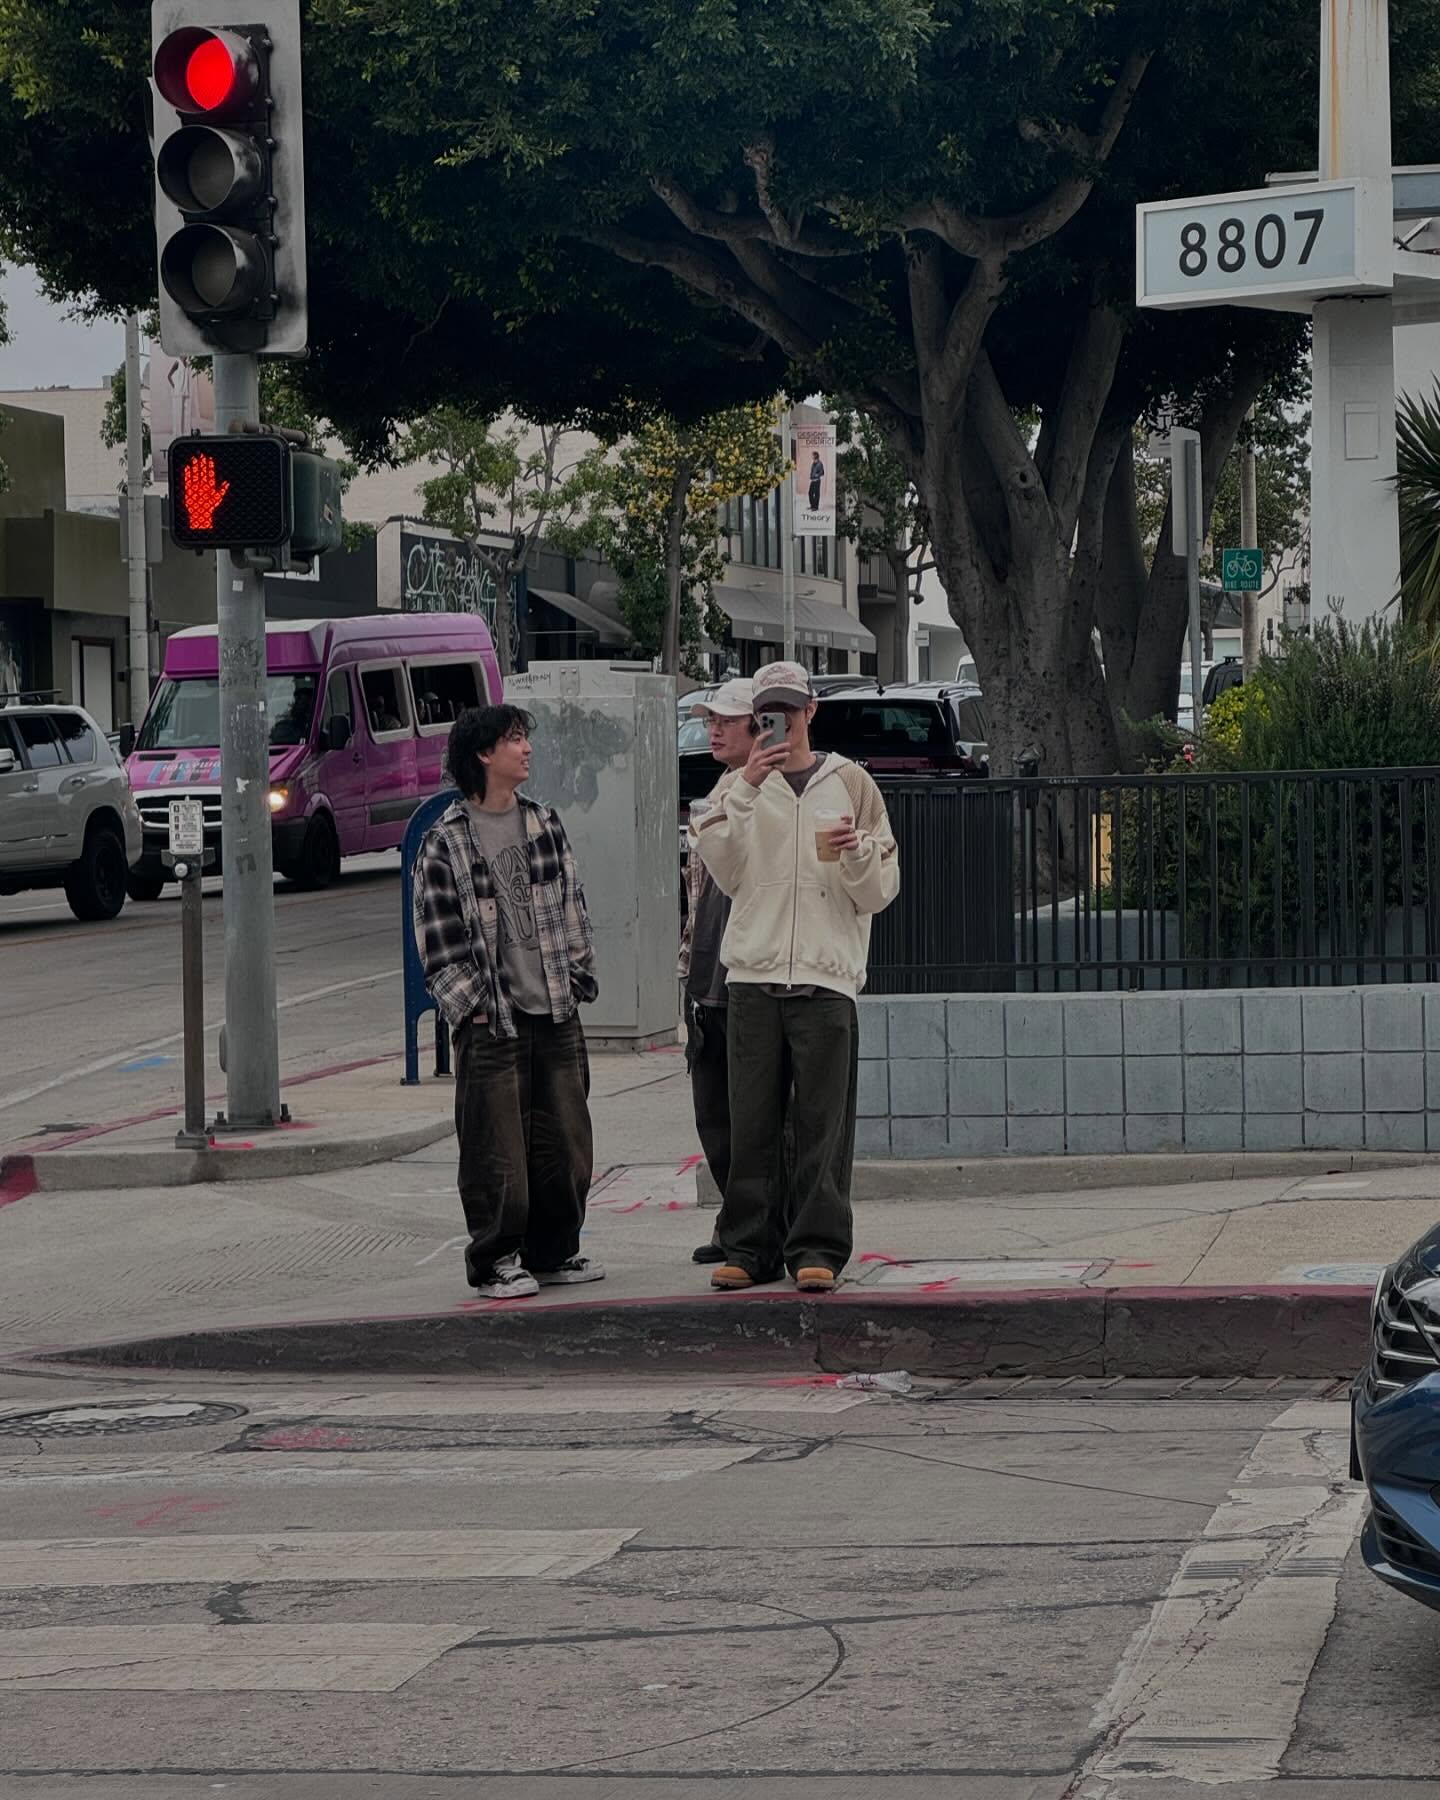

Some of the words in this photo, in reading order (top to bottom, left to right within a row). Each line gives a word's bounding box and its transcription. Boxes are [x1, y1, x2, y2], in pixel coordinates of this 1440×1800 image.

[1179, 208, 1324, 277] 8807
[801, 514, 830, 522] Theory
[1225, 581, 1237, 589] BIKE
[1241, 581, 1259, 589] ROUTE
[162, 759, 222, 772] HOLLYWO
